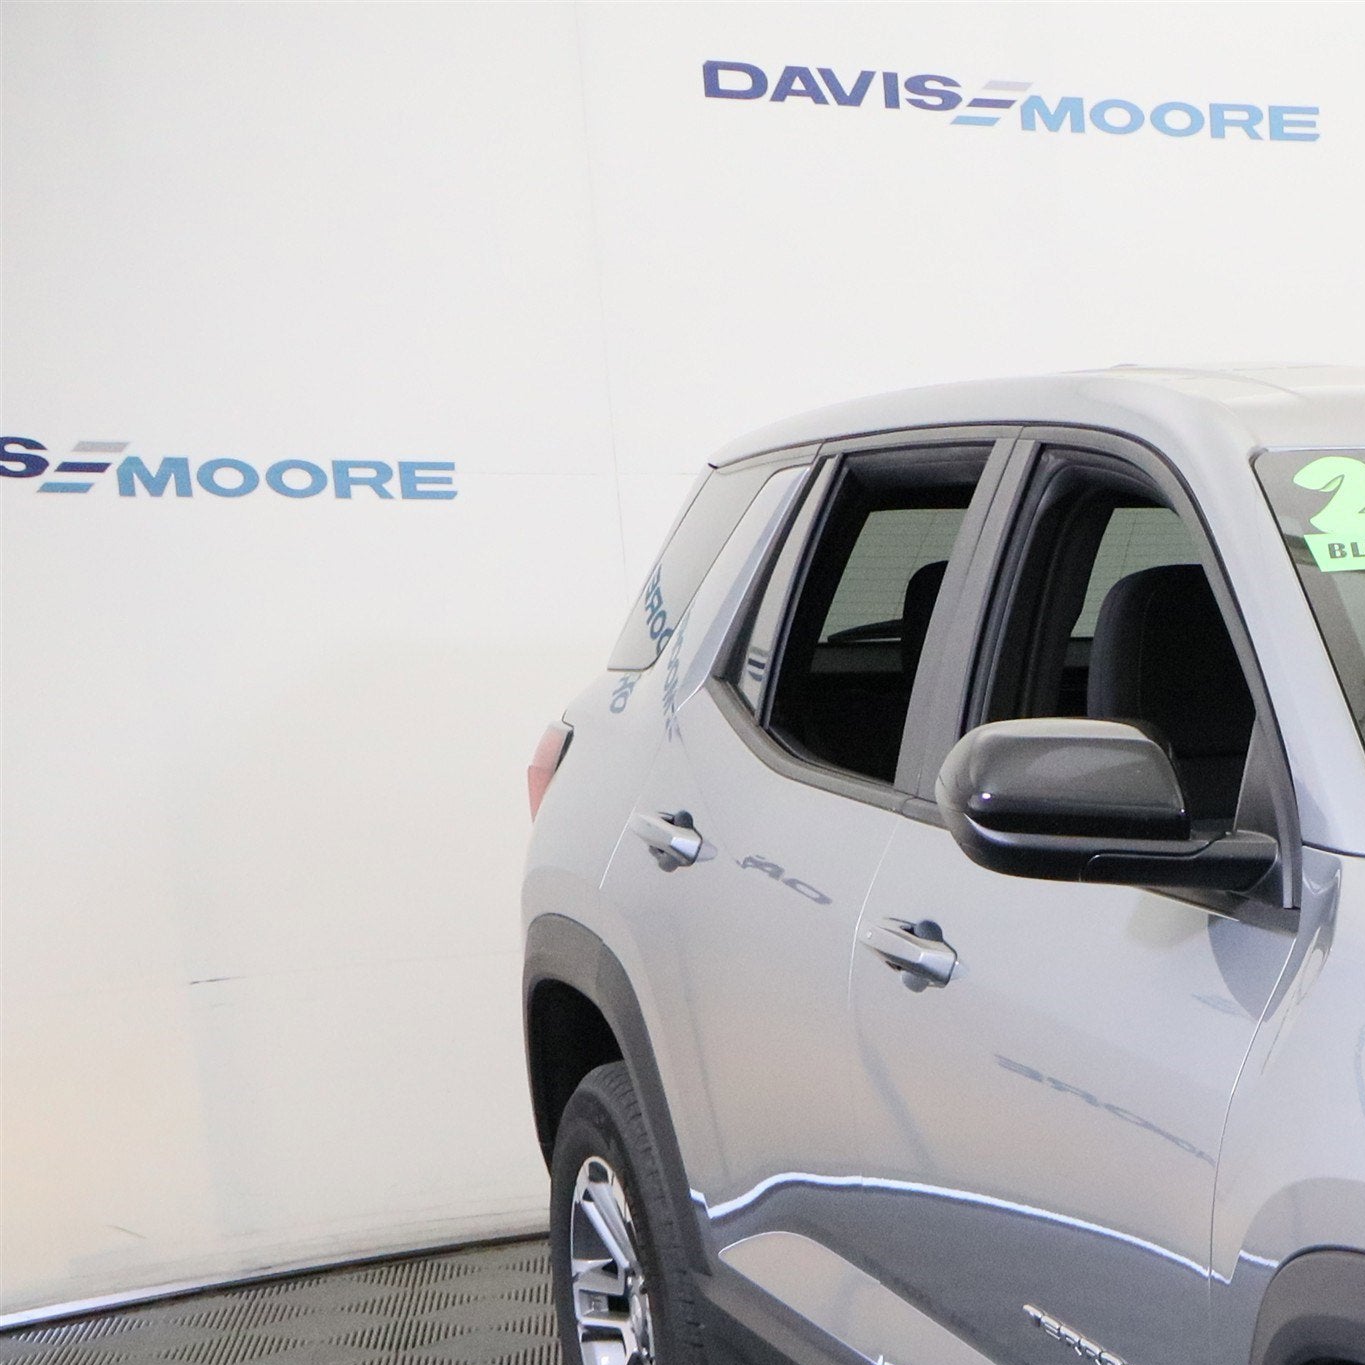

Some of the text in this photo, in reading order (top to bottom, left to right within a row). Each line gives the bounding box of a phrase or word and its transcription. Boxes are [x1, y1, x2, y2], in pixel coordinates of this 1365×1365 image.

[704, 60, 1319, 142] DAVIS MOORE
[117, 456, 458, 500] MOORE
